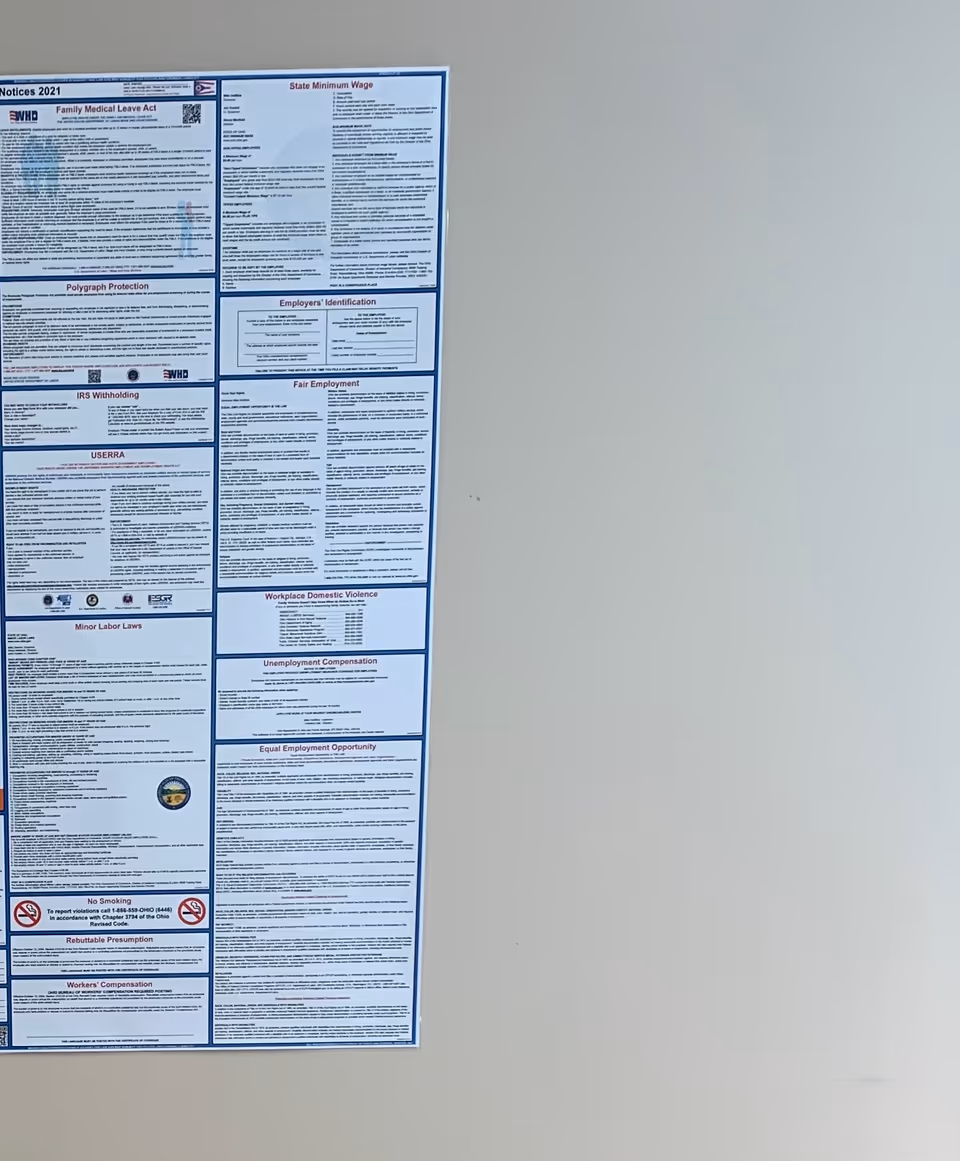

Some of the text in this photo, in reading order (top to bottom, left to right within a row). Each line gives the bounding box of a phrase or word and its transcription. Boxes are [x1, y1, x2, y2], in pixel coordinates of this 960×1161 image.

[290, 80, 373, 91] State Minimum Wage
[38, 87, 61, 96] 2021
[56, 104, 156, 116] Family Medical Leave Act
[66, 282, 149, 293] Polygraph Protection
[280, 298, 376, 309] Employers' Identification
[293, 379, 359, 390] Fair Employment
[77, 390, 139, 401] IRS Withholding
[91, 451, 125, 459] USERRA
[265, 590, 378, 601] Workplace Domestic Violence
[98, 622, 120, 630] Labor
[121, 622, 142, 630] Laws
[263, 657, 377, 668] Unemployment Compensation
[259, 743, 376, 754] Equal Employment Opportunity
[99, 897, 132, 906] Smoking
[66, 935, 153, 945] Rebuttable Presumption
[100, 980, 152, 990] Compensation
